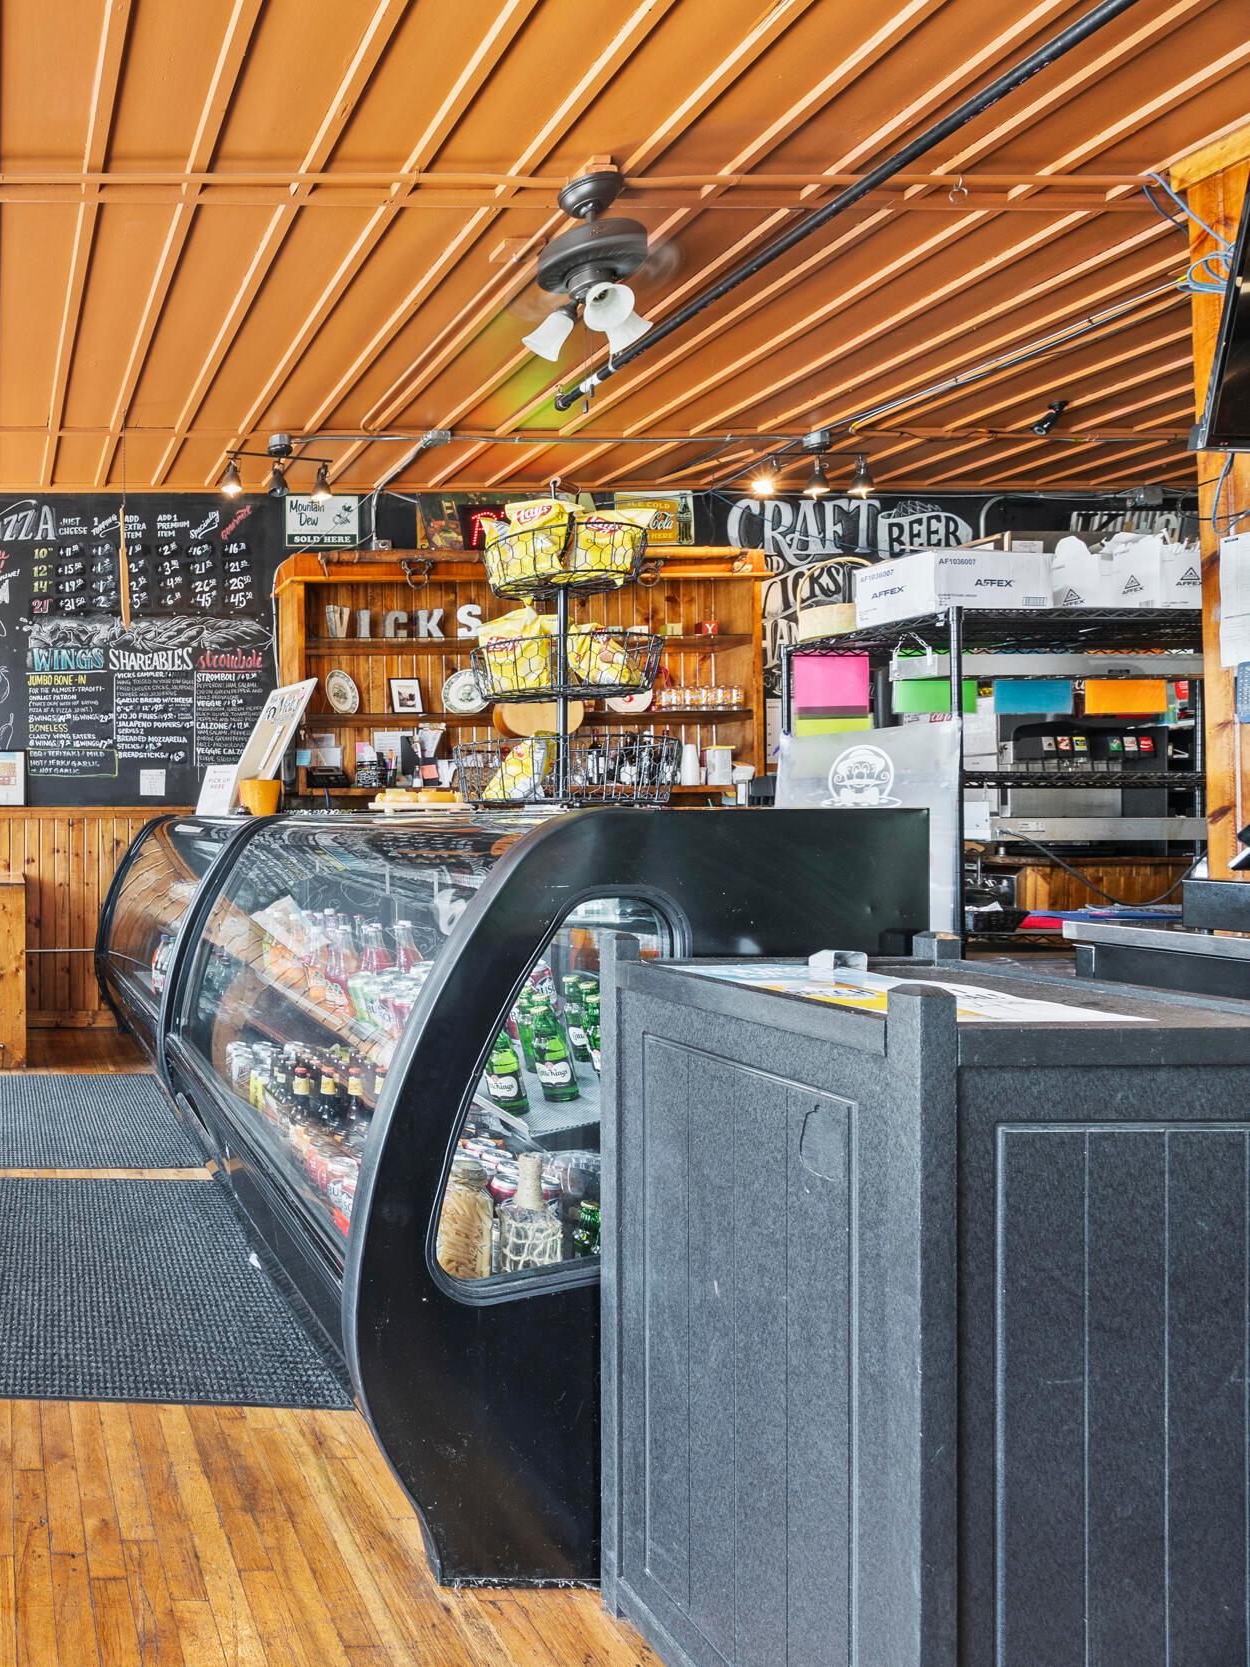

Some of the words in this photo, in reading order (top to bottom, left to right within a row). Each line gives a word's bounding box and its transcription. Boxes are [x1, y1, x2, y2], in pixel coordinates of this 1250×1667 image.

[289, 499, 325, 513] Mountain
[60, 517, 81, 526] JUST
[157, 514, 172, 522] ADD
[298, 512, 319, 527] Dew
[124, 523, 146, 532] EXTRA
[157, 521, 189, 530] PREMIUM
[58, 527, 88, 536] CHEESE
[124, 531, 142, 539] ITEM
[727, 498, 881, 566] CRAFT
[888, 514, 961, 558] BEER
[293, 535, 320, 544] SOLD
[323, 535, 352, 544] HERE
[938, 558, 976, 566] AF1036007
[974, 578, 1015, 588] AFFEX
[871, 585, 906, 600] AFFEX
[1121, 586, 1144, 595] AFFEX
[325, 603, 482, 639] VICKS
[32, 647, 104, 671] WINGS
[109, 647, 193, 671] SHAREABLES
[28, 674, 52, 686] JUMBO
[54, 675, 73, 685] BONE
[196, 672, 236, 683] STROMBOLI
[196, 700, 222, 708] VEGGIE
[29, 723, 68, 733] BONELESS
[117, 720, 153, 728] JALAPENO
[196, 722, 228, 730] CALZONE
[147, 735, 188, 743] MOZZARELLA
[196, 747, 222, 756] VEGGIE
